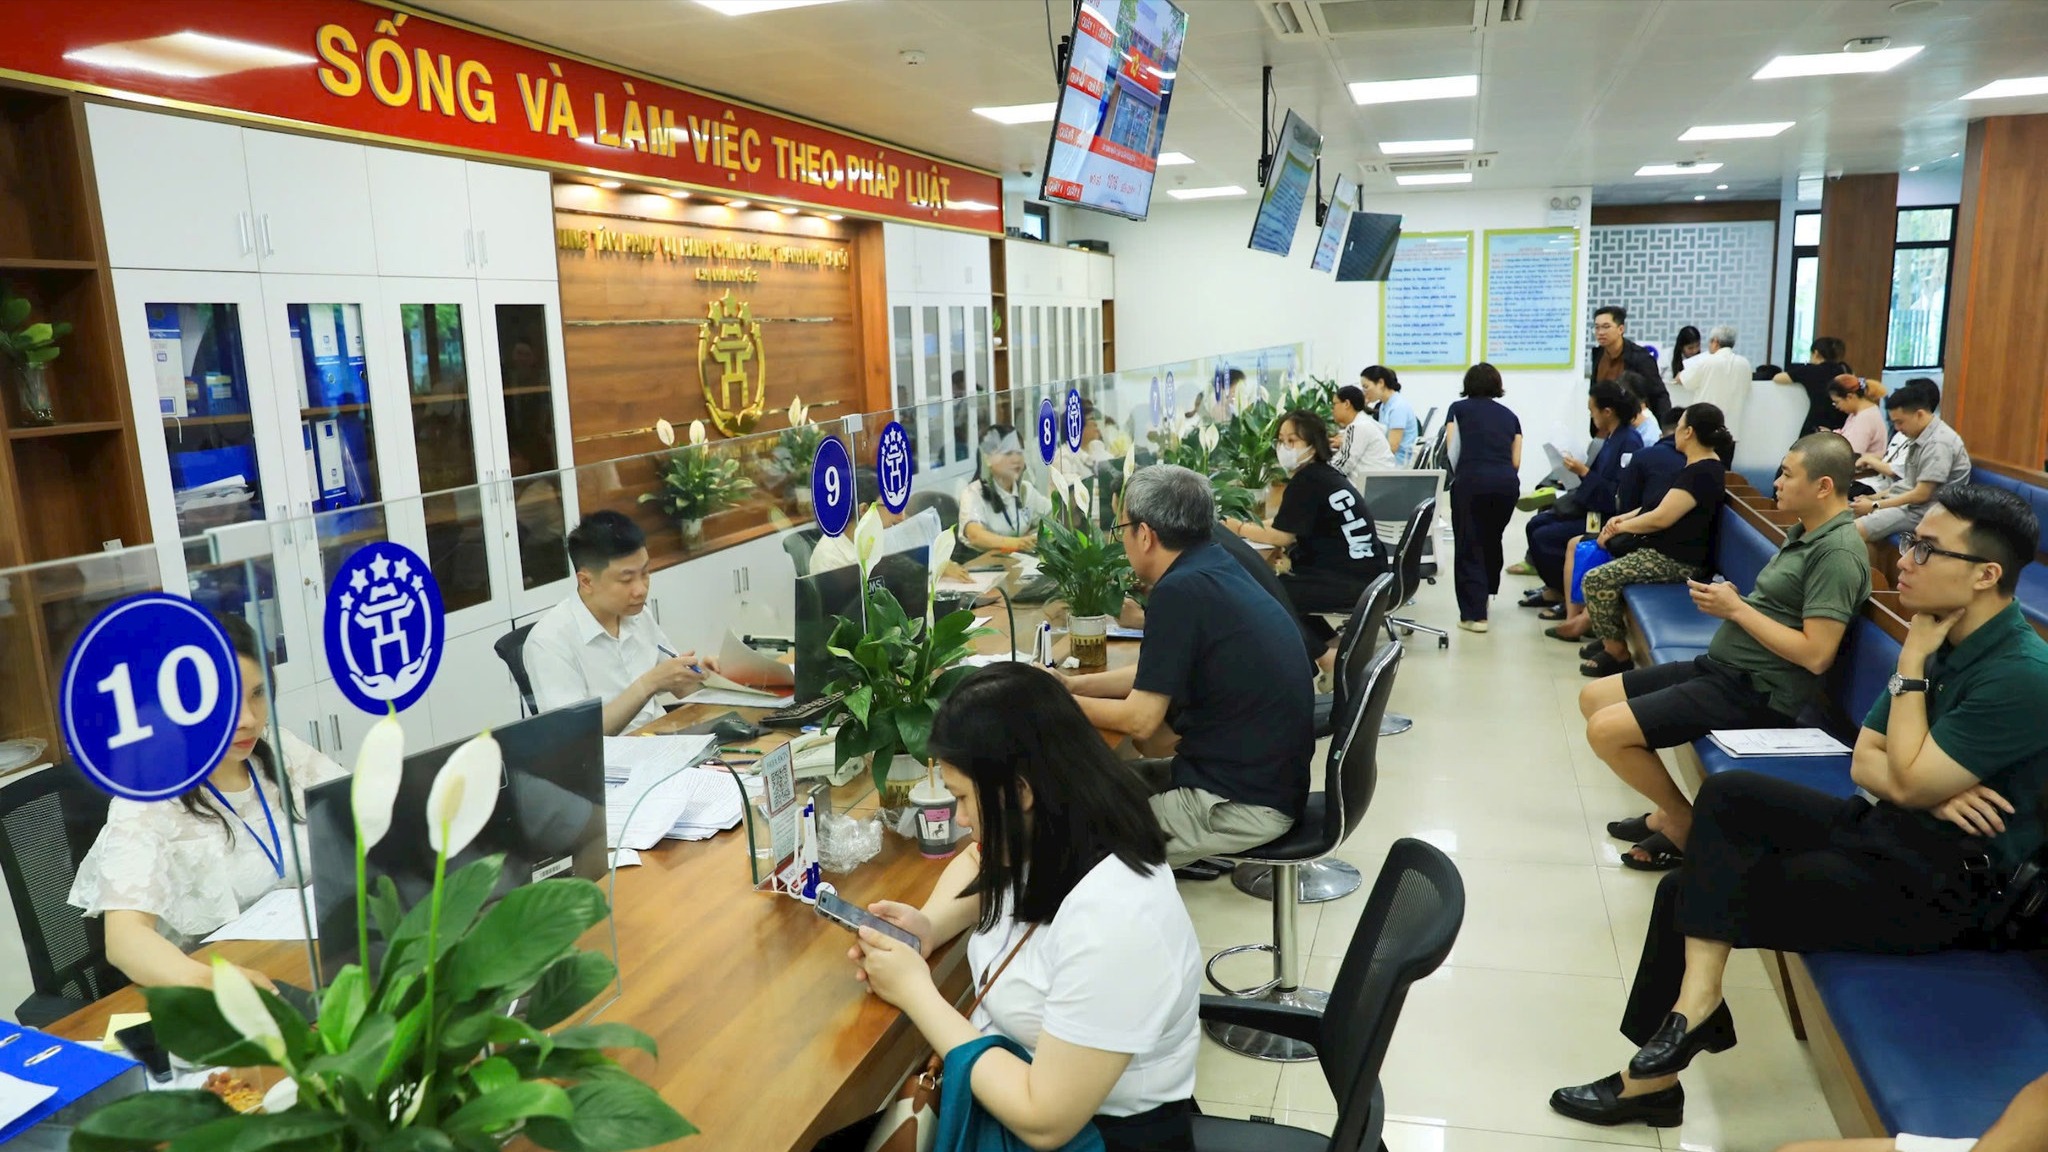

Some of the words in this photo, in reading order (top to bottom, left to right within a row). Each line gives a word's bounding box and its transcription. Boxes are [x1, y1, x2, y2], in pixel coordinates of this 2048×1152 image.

[316, 13, 497, 124] SỐNG
[516, 62, 579, 139] VÀ
[594, 82, 677, 158] LÀM
[687, 109, 762, 181] VIỆC
[770, 136, 838, 190] THEO
[846, 151, 900, 199] PHÁP
[905, 165, 950, 216] LUẬT
[1043, 417, 1051, 446] 8
[825, 466, 840, 506] 9
[96, 644, 220, 750] 10
